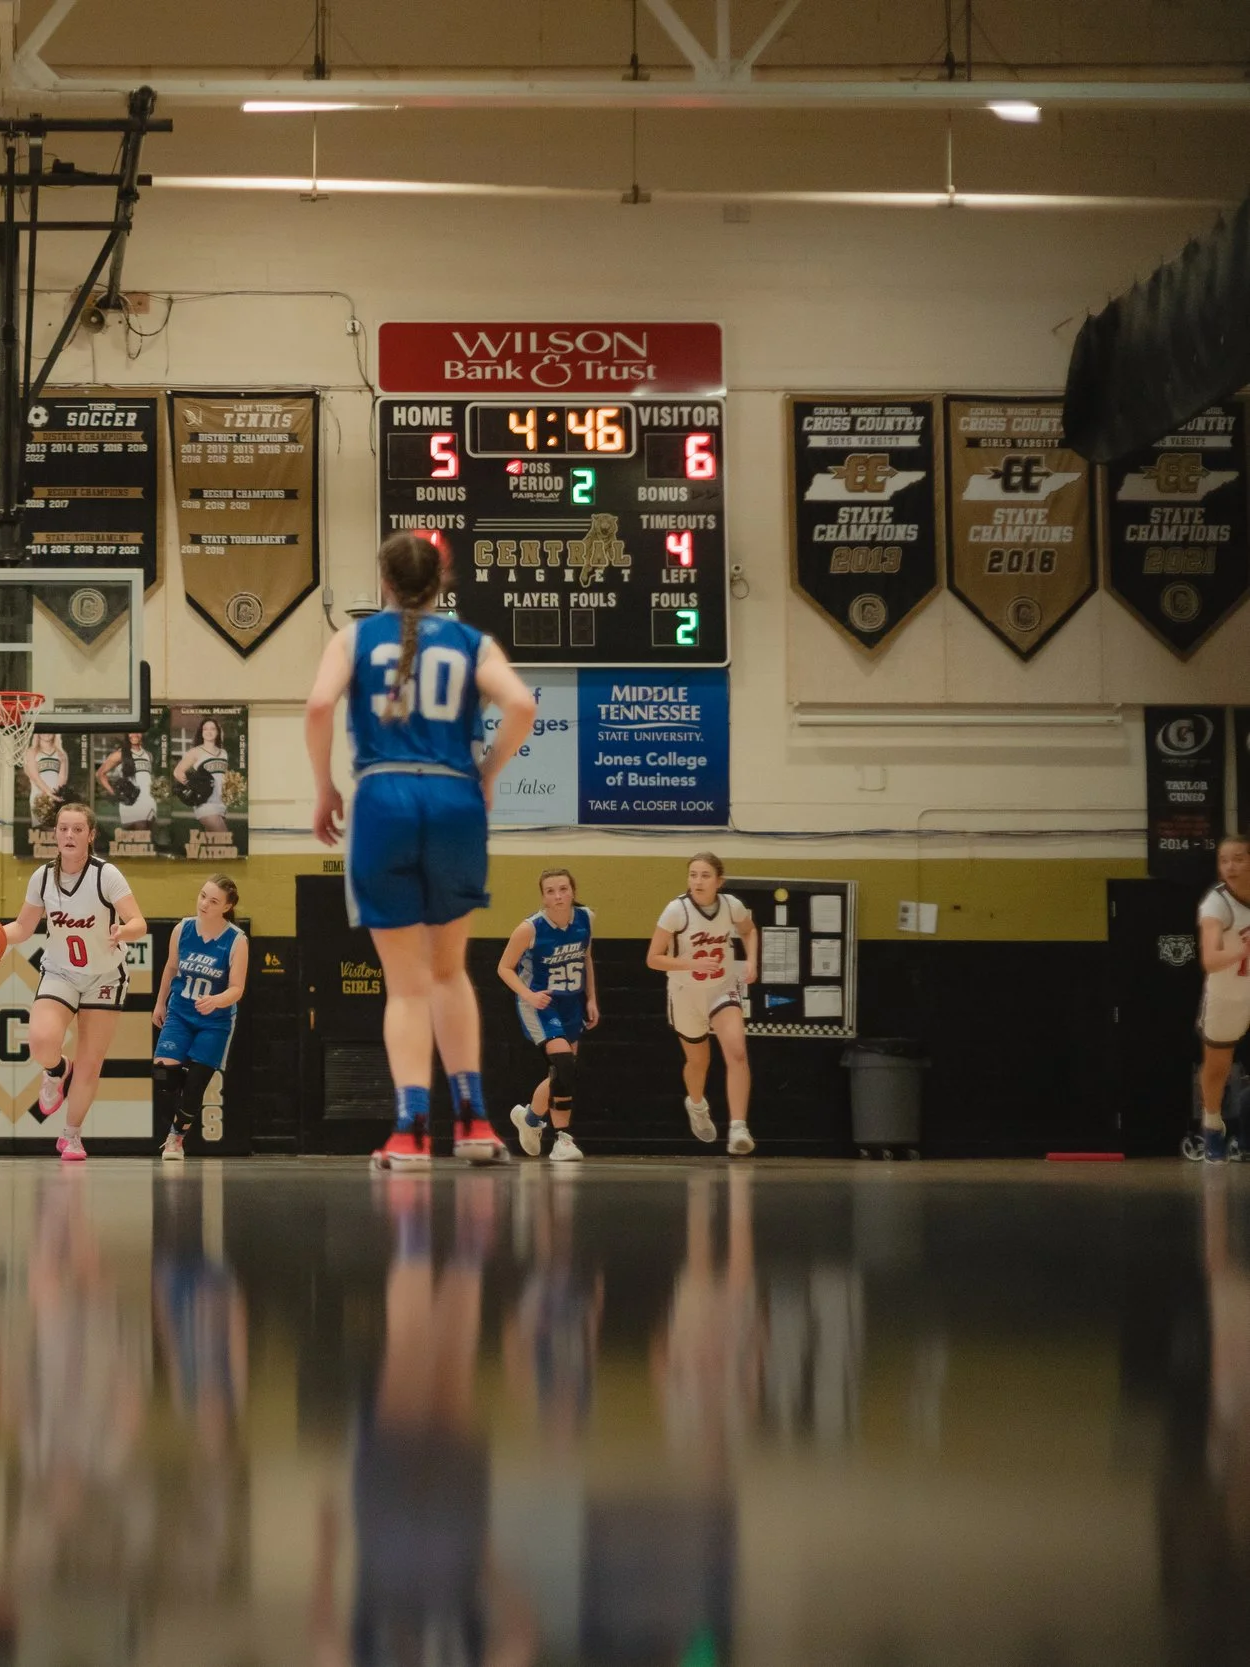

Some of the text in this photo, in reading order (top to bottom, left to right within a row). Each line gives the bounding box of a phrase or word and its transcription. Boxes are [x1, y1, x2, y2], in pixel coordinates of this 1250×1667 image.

[453, 332, 646, 358] WILSON
[445, 355, 656, 387] Bank & Trust
[67, 412, 137, 427] SOCCER
[224, 414, 293, 428] TENNIS
[394, 407, 452, 426] HOME
[638, 407, 719, 426] VISITOR
[803, 416, 924, 431] CROSS COUNTRY
[959, 417, 1008, 432] CROSS
[199, 434, 289, 442] DISTRICT CHAMPIONS
[509, 409, 623, 451] 4:46
[827, 437, 900, 446] BOYS VARSITY
[980, 438, 1059, 448] GIRLS VARSITY
[430, 434, 458, 478] 5
[685, 434, 713, 478] 6
[522, 462, 550, 474] POSS
[509, 476, 563, 491] PERIOD
[572, 470, 593, 504] 2
[235, 490, 285, 498] CHAMPIONS
[417, 487, 466, 501] BONUS
[638, 487, 687, 501] BONUS
[390, 515, 465, 529] TIMEOUTS
[640, 515, 715, 529] TIMEOUTS
[838, 507, 894, 524] STATE
[993, 508, 1048, 524] STATE
[1151, 507, 1205, 524] STATE
[202, 535, 286, 544] STATE TOURNAMENT
[813, 525, 918, 541] CHAMPIONS
[969, 526, 1073, 542] CHAMPIONS
[1126, 525, 1230, 542] CHAMPIONS
[475, 541, 631, 567] CENTRAL
[667, 532, 692, 566] 4
[830, 547, 902, 573] 2013
[476, 569, 630, 581] MAGNET
[662, 570, 697, 583] LEFT
[504, 593, 616, 607] PLAYER FOULS
[652, 593, 697, 607] FOULS
[676, 611, 697, 644] 2
[611, 685, 688, 702] MIDDLE
[598, 705, 701, 721] TENNESSEE
[598, 732, 629, 741] STATE
[594, 752, 707, 769] Jones College
[515, 779, 555, 795] false
[606, 772, 696, 786] of Business
[1166, 781, 1207, 790] TAYLOR
[589, 801, 714, 811] TAKE A CLOSER LOOK
[1160, 840, 1189, 850] 2014
[51, 911, 95, 929] Heat
[66, 935, 88, 967] 0
[188, 952, 217, 966] LADY
[179, 962, 223, 978] FALCONS
[341, 961, 382, 978] Visitors
[549, 963, 584, 992] 25
[181, 976, 212, 1000] 10
[343, 981, 380, 994] GIRLS
